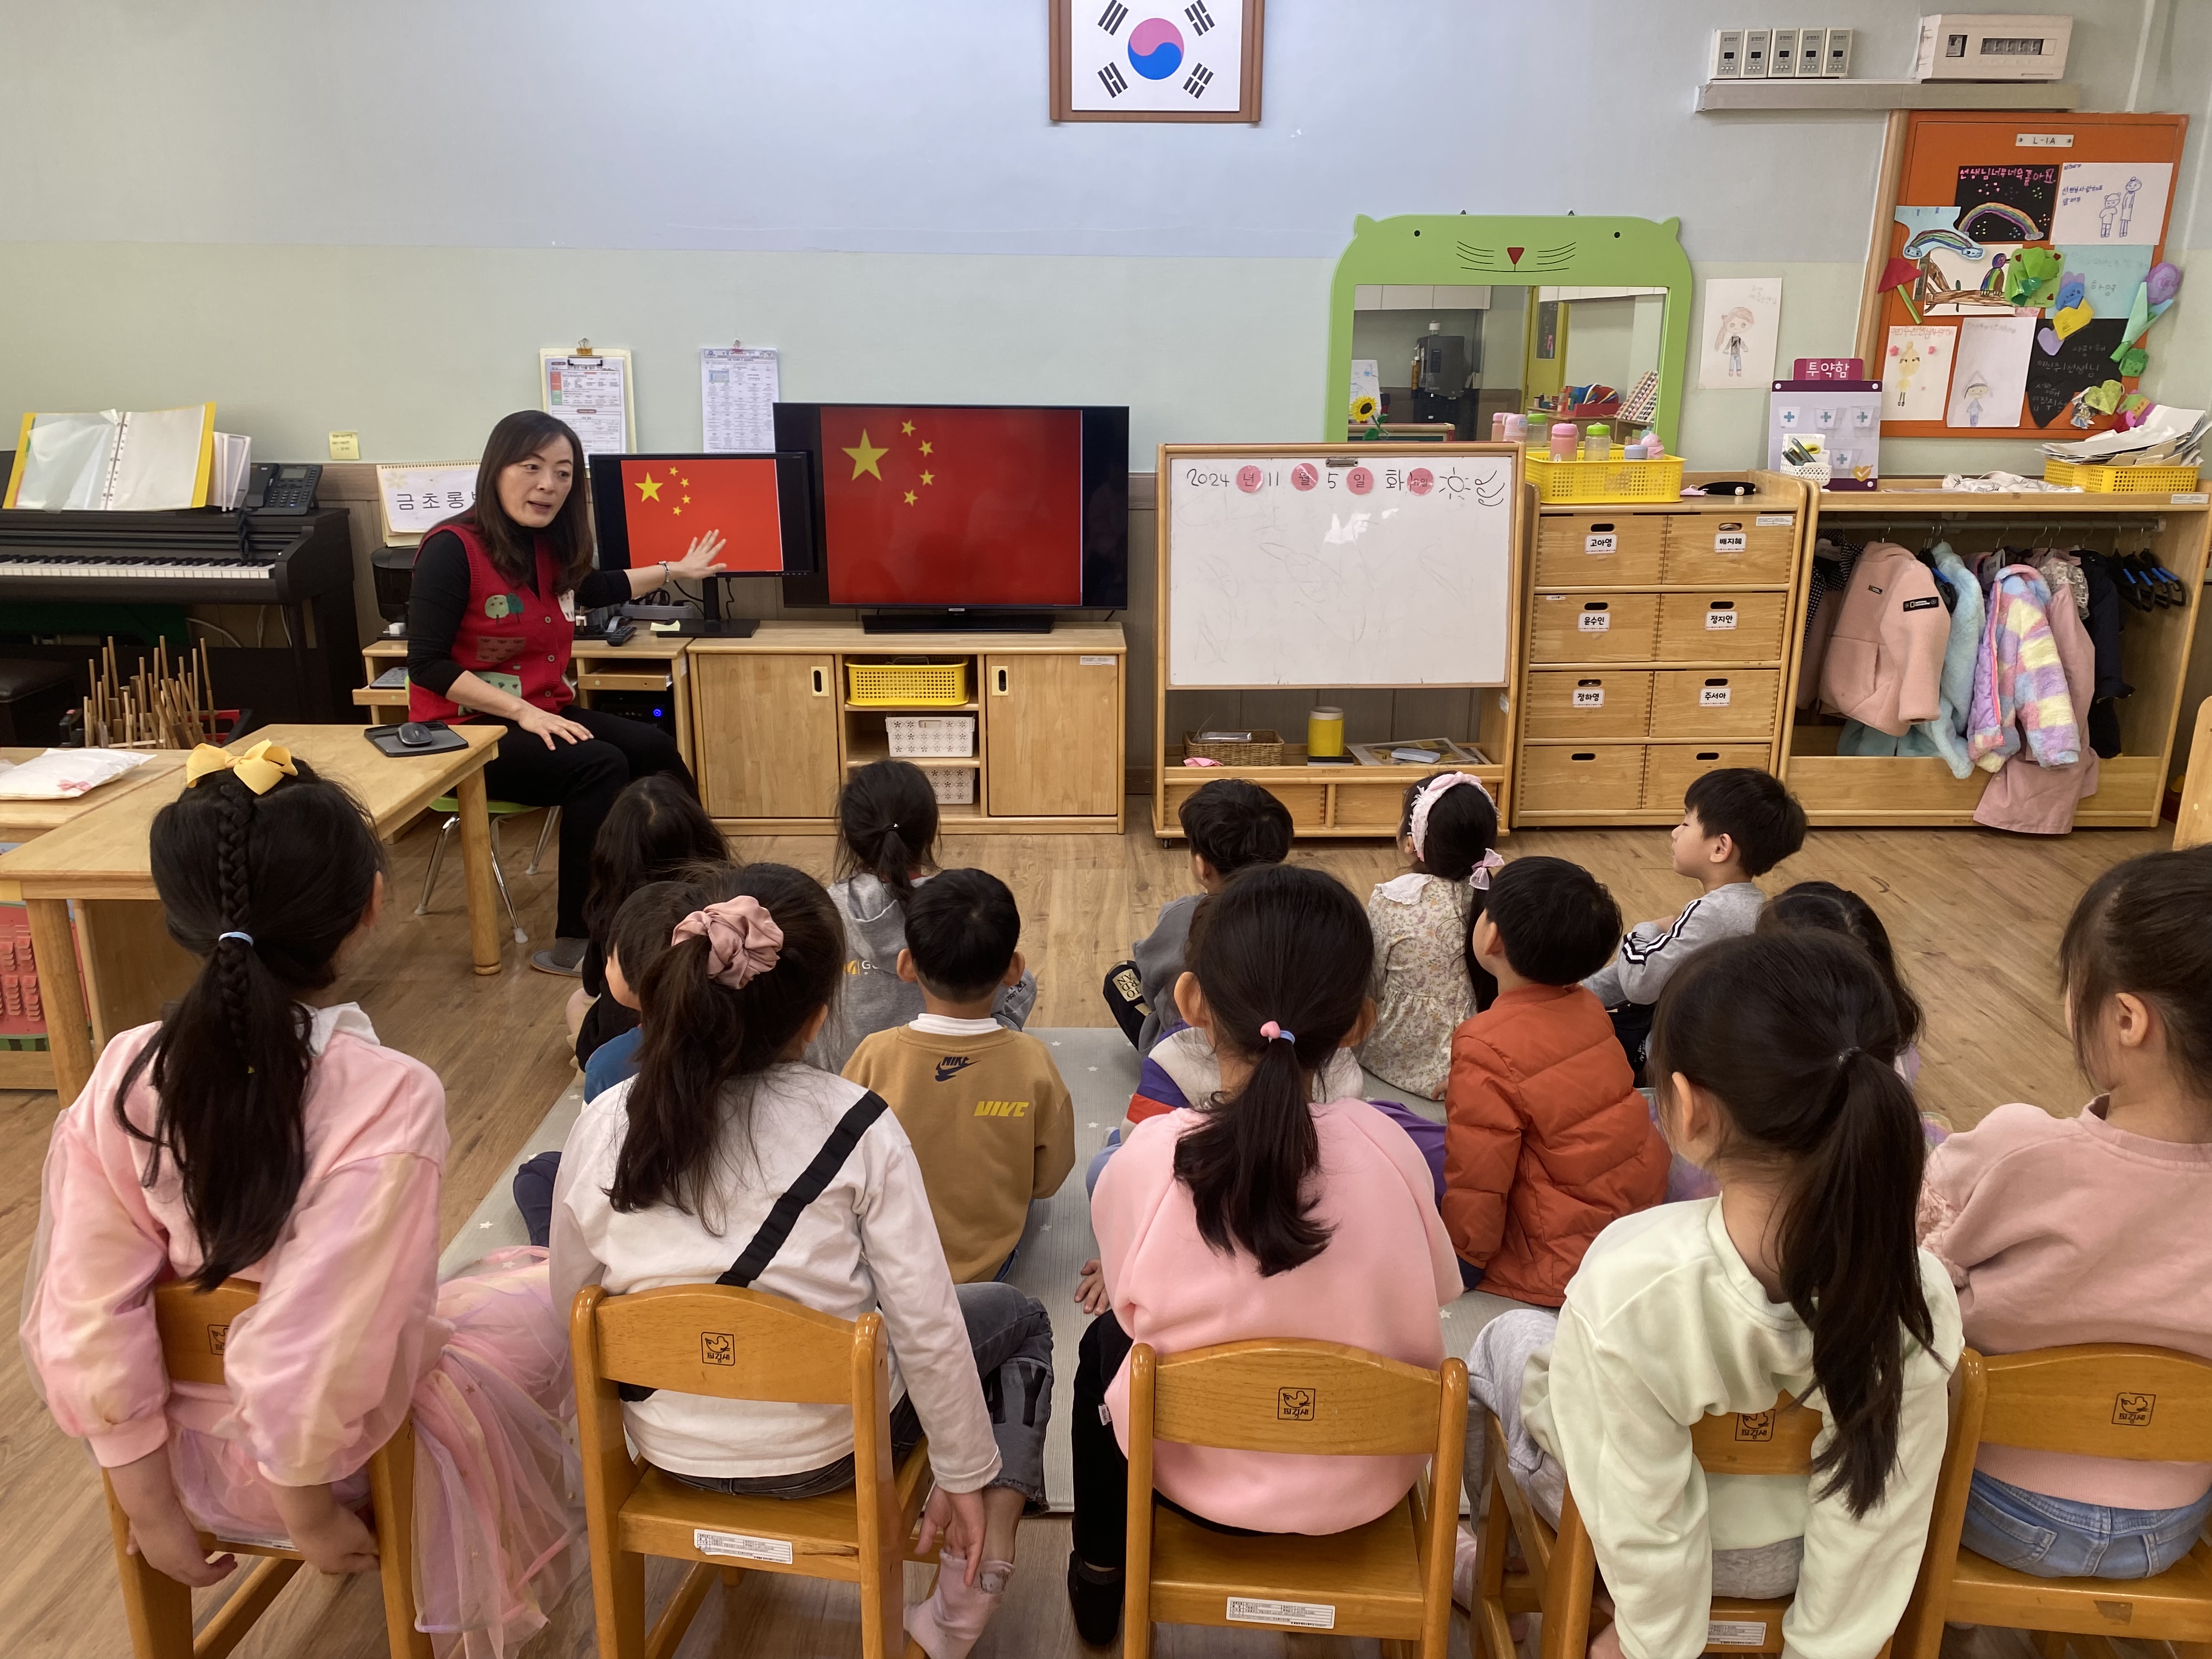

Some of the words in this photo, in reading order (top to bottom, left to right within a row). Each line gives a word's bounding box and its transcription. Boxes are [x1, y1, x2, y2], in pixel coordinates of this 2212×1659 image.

[1807, 361, 1849, 378] 투약함
[1187, 469, 1230, 487] 2024
[1243, 472, 1254, 486] 년
[1268, 472, 1279, 486] 11
[1299, 471, 1310, 486] 월
[1328, 472, 1339, 488] 5
[1353, 474, 1365, 488] 일
[1590, 539, 1612, 548] 고아영
[1719, 538, 1742, 546] 배지혜
[1710, 615, 1733, 624] 정지안
[1577, 692, 1600, 702] 정하영
[941, 1057, 969, 1066] NIKE
